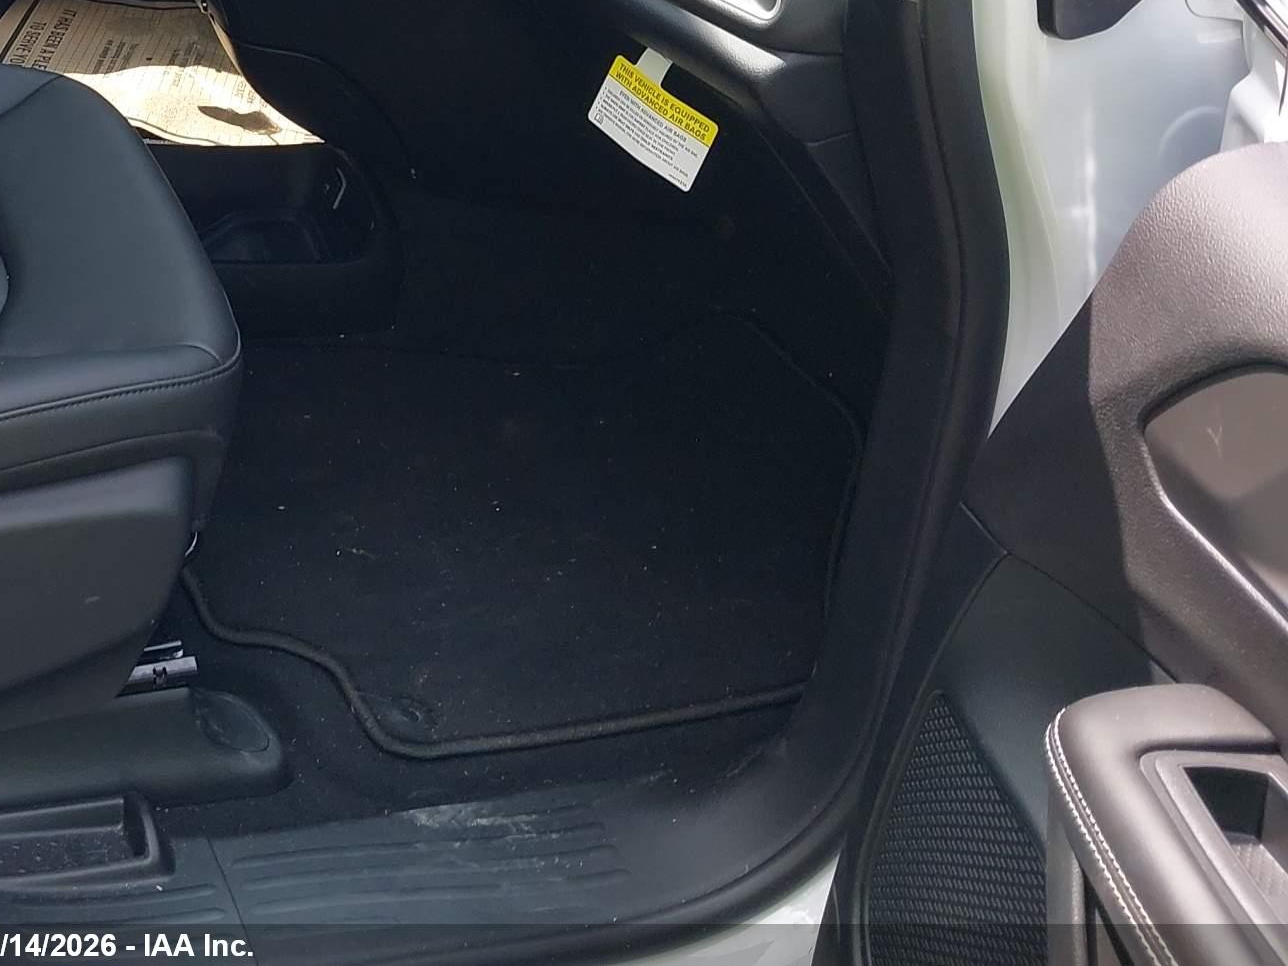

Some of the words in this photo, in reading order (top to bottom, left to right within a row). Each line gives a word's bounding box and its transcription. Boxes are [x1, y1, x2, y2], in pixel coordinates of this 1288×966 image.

[30, 22, 47, 30] TO
[54, 16, 72, 31] HAS
[16, 31, 41, 52] SERVE
[43, 31, 66, 49] BEEN
[615, 72, 631, 87] WITH
[632, 85, 668, 116] ADVANCED
[669, 114, 684, 126] AIR
[684, 123, 707, 141] BAGS
[619, 64, 634, 79] THIS
[635, 75, 661, 100] VEHICLE
[661, 96, 669, 106] IS
[670, 103, 710, 132] EQUIPPED
